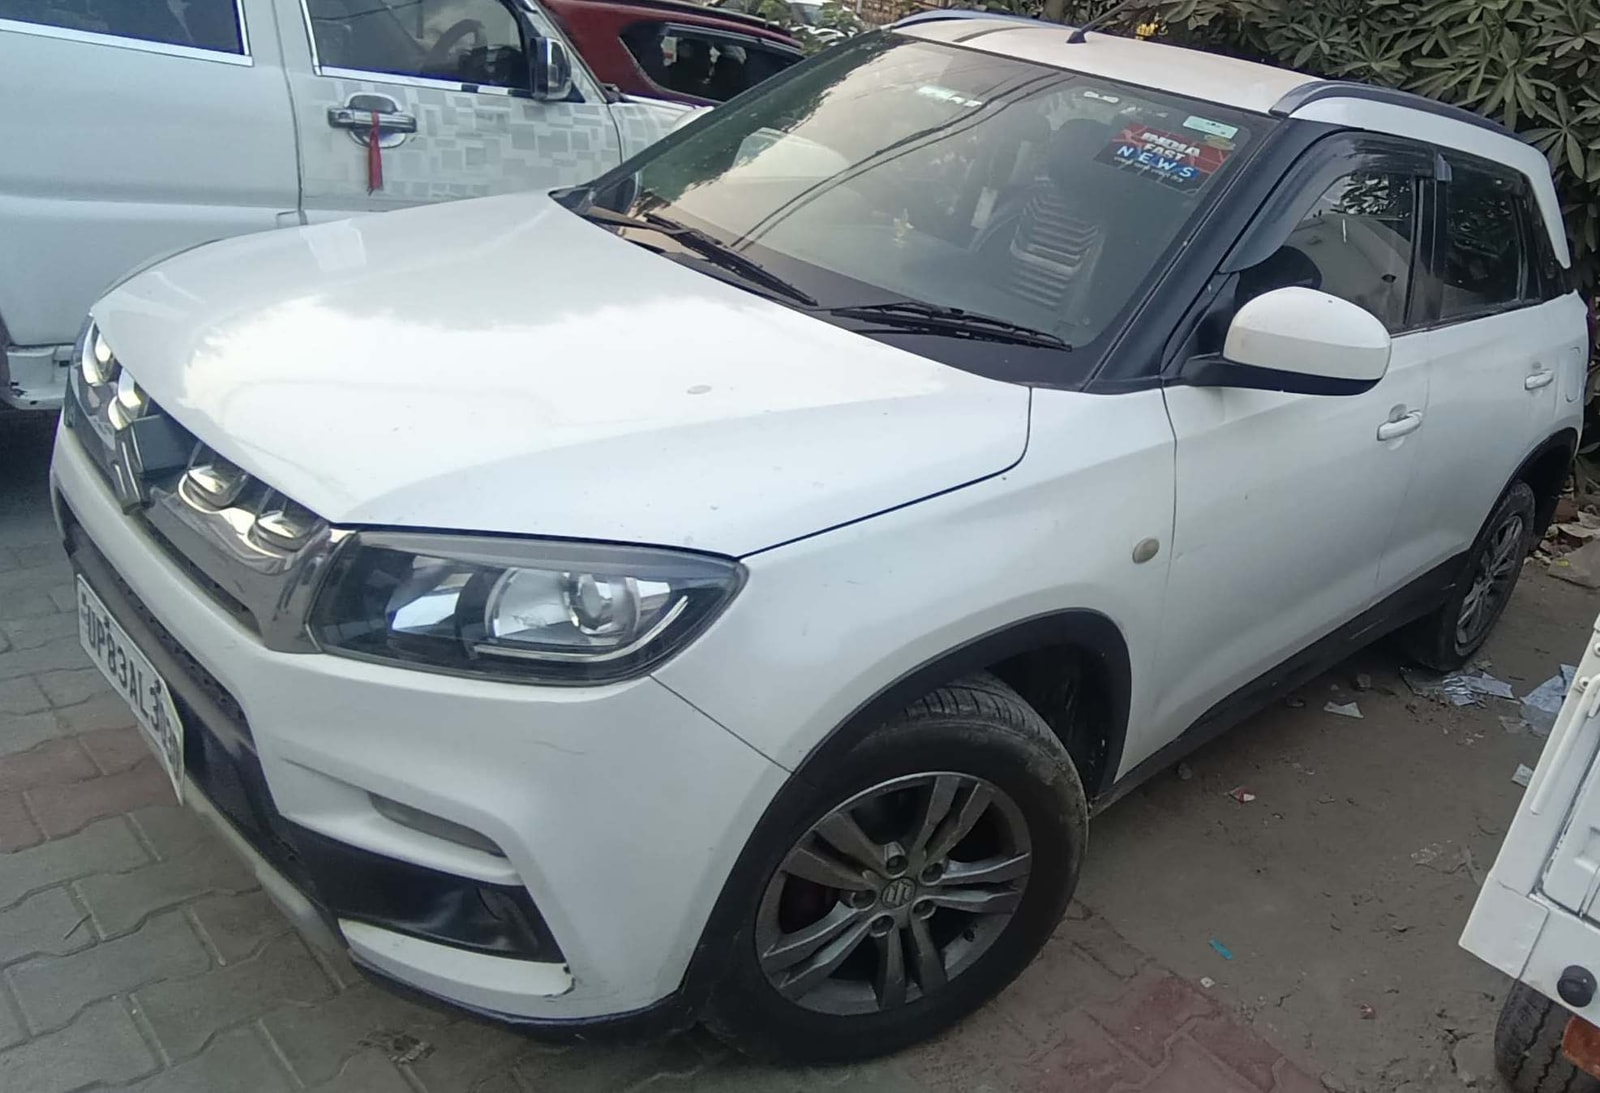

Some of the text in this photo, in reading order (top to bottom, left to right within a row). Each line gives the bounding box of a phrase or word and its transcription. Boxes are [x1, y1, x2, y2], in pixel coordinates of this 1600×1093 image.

[1141, 132, 1200, 157] INDIA
[1143, 143, 1186, 161] FAST
[1116, 145, 1194, 178] NEWS
